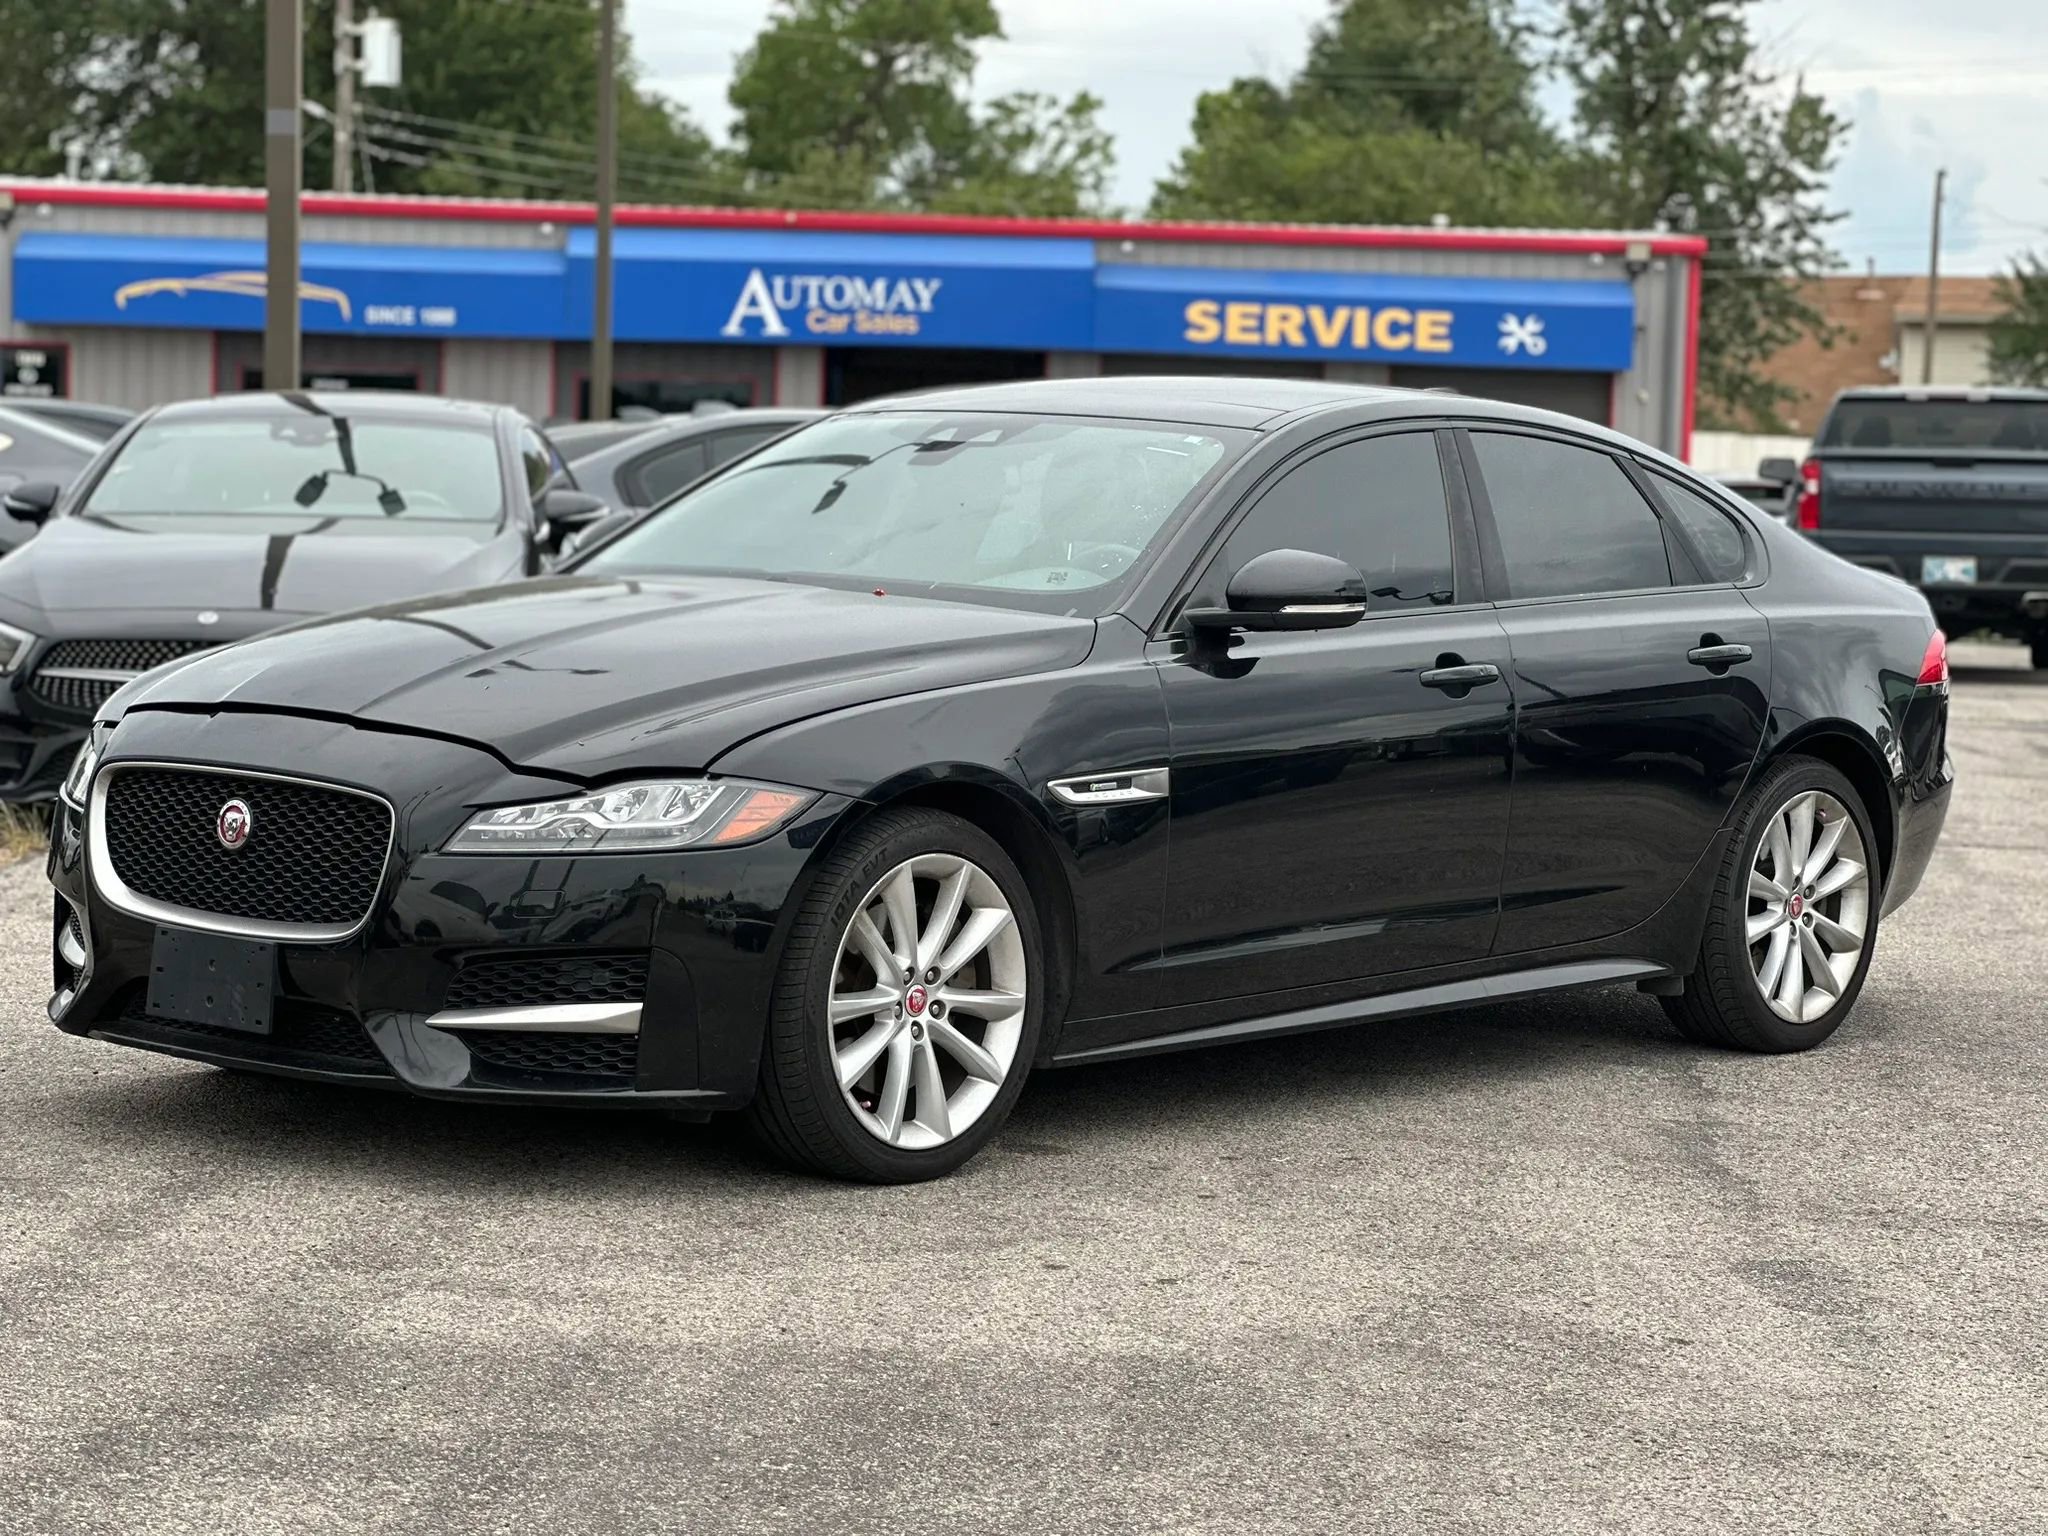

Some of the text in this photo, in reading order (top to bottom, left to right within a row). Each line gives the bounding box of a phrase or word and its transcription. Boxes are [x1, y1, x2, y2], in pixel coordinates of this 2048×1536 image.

[364, 304, 416, 326] SINCE
[721, 268, 941, 336] AUTOMAY
[806, 307, 919, 335] Car Sales
[1185, 300, 1454, 353] SERVICE
